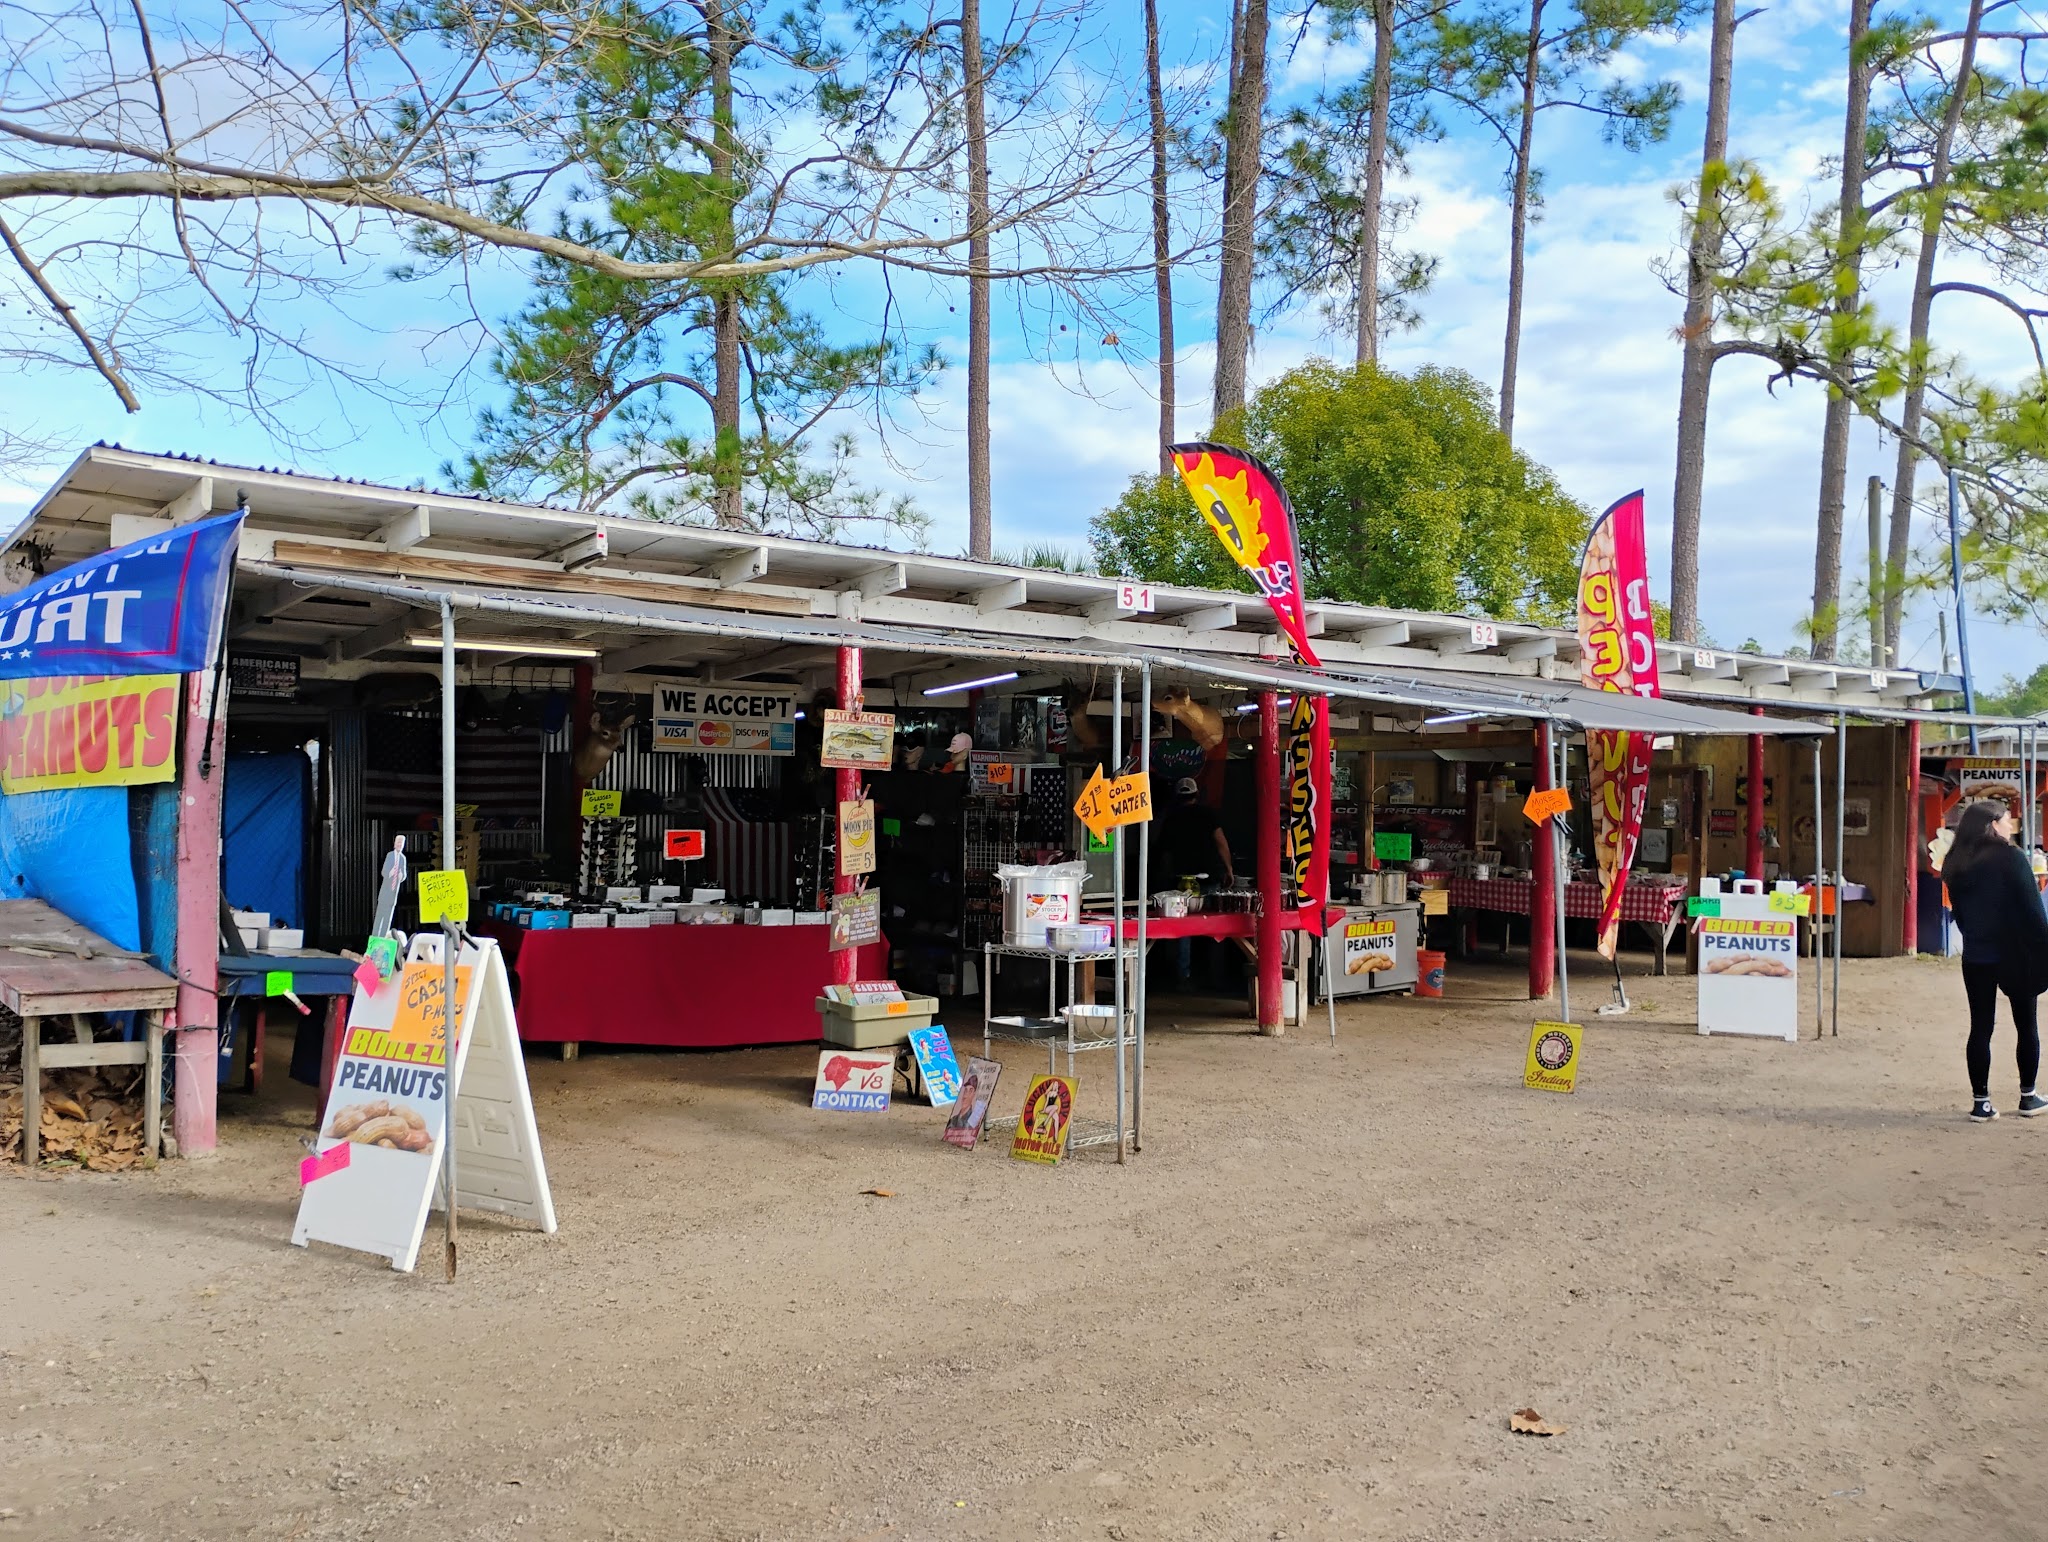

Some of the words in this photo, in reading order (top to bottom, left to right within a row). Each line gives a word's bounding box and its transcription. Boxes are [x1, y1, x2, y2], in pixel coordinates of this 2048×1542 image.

[1123, 587, 1148, 608] 51
[1476, 626, 1493, 642] 52
[232, 657, 297, 670] AMERICANS
[1698, 651, 1711, 666] 53
[661, 689, 697, 714] WE
[703, 694, 791, 718] ACCEPT
[826, 710, 852, 721] BAIT
[664, 727, 687, 739] VISA
[735, 728, 769, 737] DISCOVER
[972, 754, 999, 762] WARNING
[1963, 758, 2020, 768] BOILED
[1963, 769, 2021, 780] PEANUTS
[1109, 783, 1133, 799] COLD
[1111, 791, 1148, 817] WATER
[1532, 794, 1556, 808] MORE
[1384, 807, 1428, 815] RACE
[426, 879, 451, 895] FRIED
[1347, 921, 1395, 937] BOILED
[1704, 919, 1792, 935] BOILED
[1347, 936, 1394, 952] PEANUTS
[1704, 935, 1791, 962] PEANUTS
[403, 969, 428, 990] SPICY
[854, 982, 896, 992] CAUTION
[338, 1061, 446, 1101] PEANUTS
[860, 1071, 883, 1090] V8
[1526, 1070, 1572, 1089] Indian
[817, 1091, 885, 1110] PONTIAC
[1013, 1137, 1042, 1152] MOTOR
[1042, 1141, 1062, 1156] OILS
